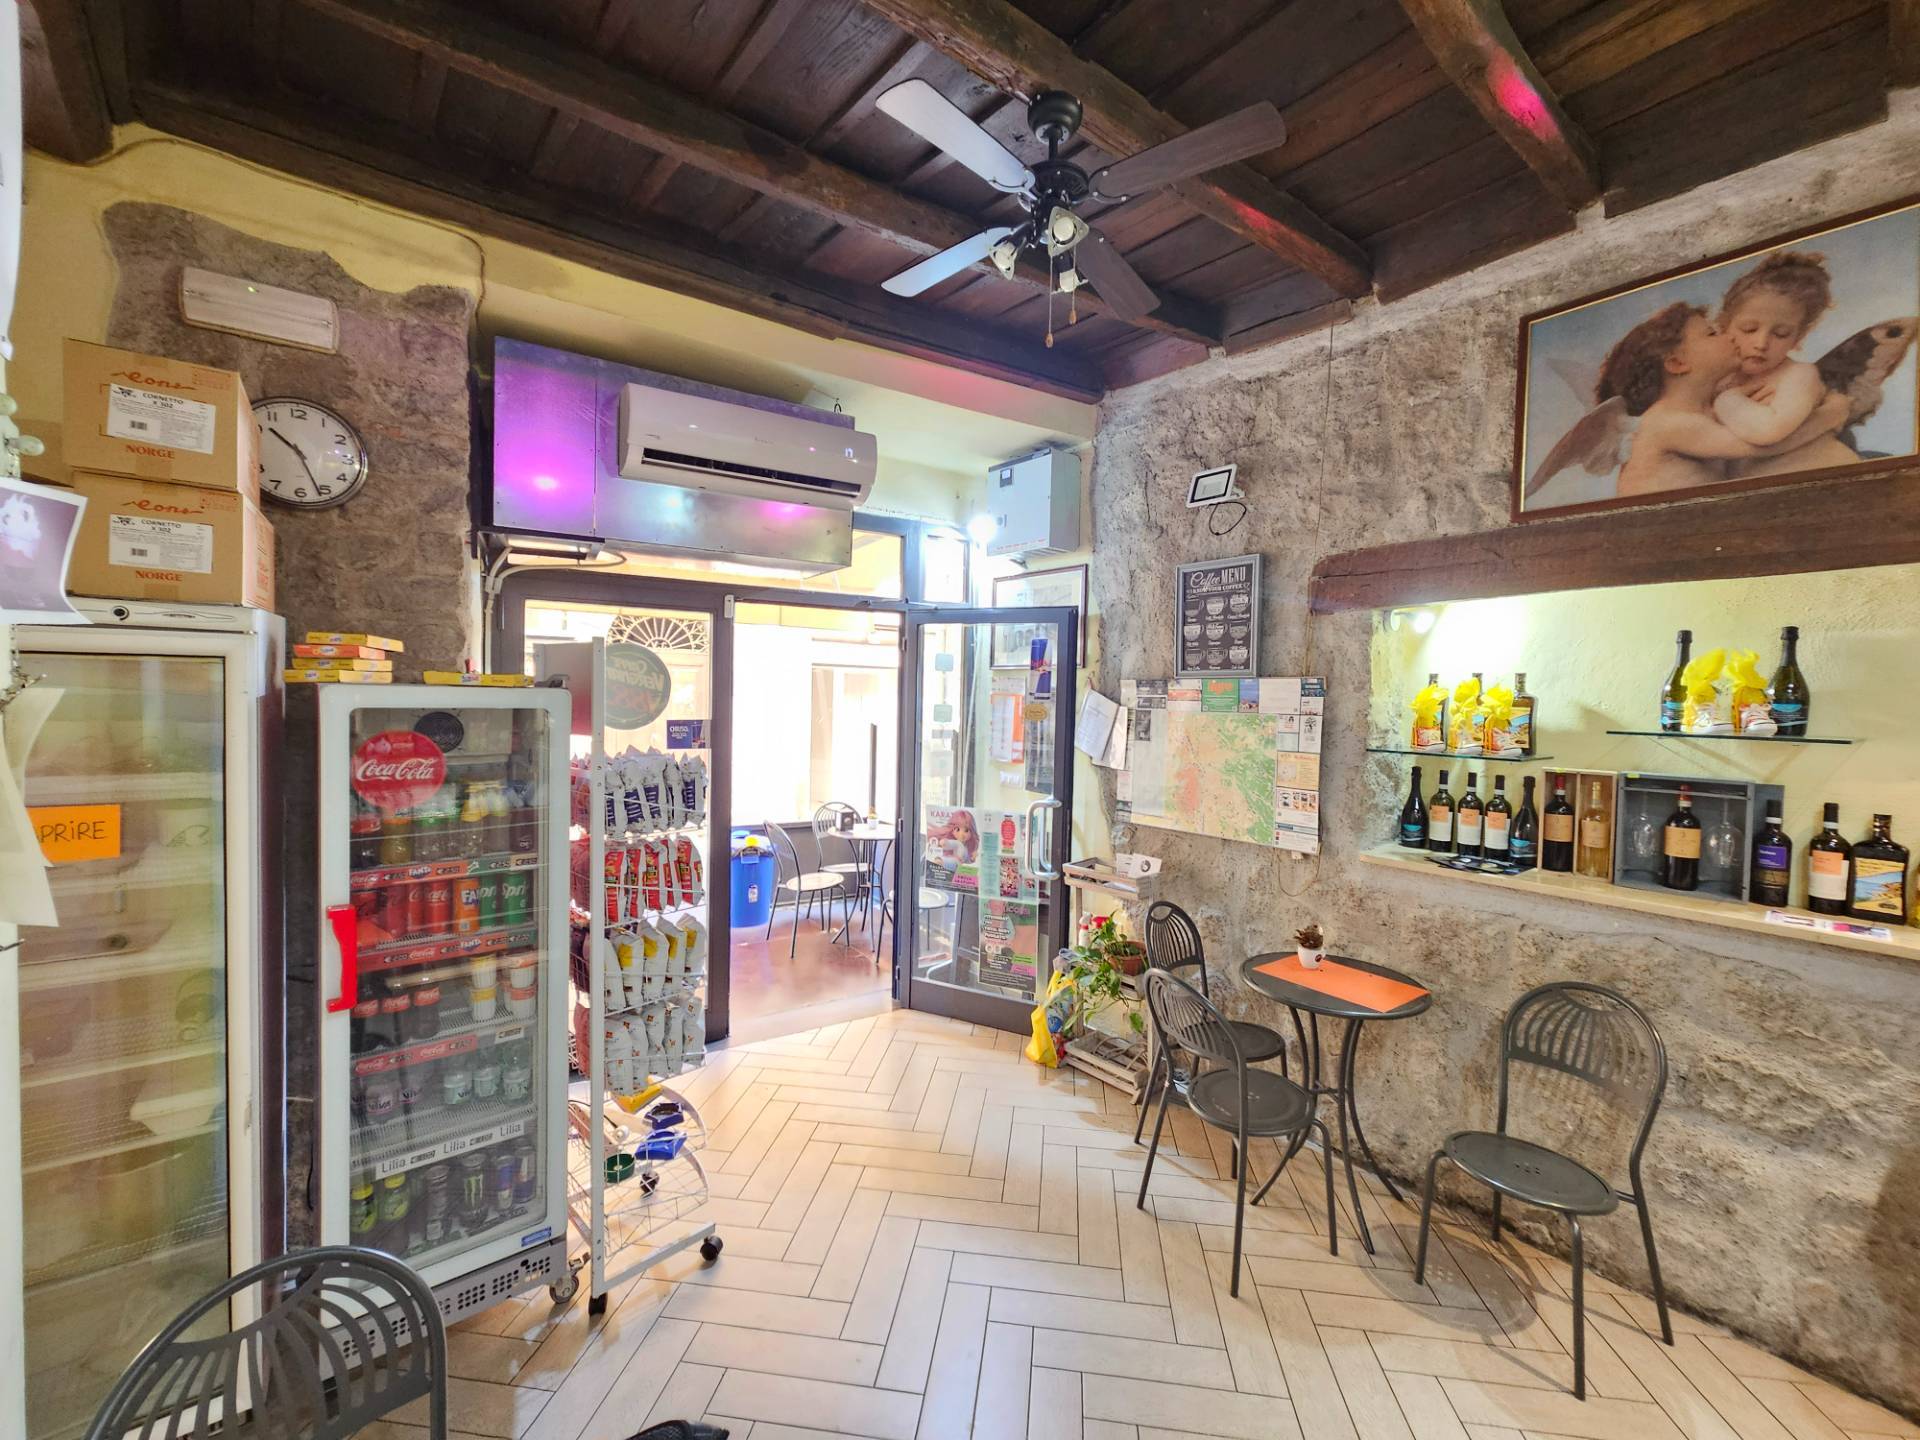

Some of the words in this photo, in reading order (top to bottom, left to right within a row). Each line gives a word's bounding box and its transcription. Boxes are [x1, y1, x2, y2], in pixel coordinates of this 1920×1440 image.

[142, 392, 184, 405] CORNETTO
[267, 411, 277, 422] 11
[290, 408, 307, 420] 12
[334, 434, 346, 446] 2
[126, 445, 175, 459] NORGE
[336, 472, 347, 483] 4
[269, 480, 282, 490] 7
[319, 485, 332, 495] 5
[294, 487, 307, 498] 6
[141, 519, 182, 529] CORNETTO
[136, 570, 183, 582] NORGE
[1191, 571, 1221, 590] Coffee
[1221, 566, 1246, 584] MENU
[356, 758, 439, 782] Coca-Cola
[382, 1158, 406, 1173] Lilia
[443, 1140, 466, 1154] Lilia
[500, 1123, 522, 1137] Lilia
